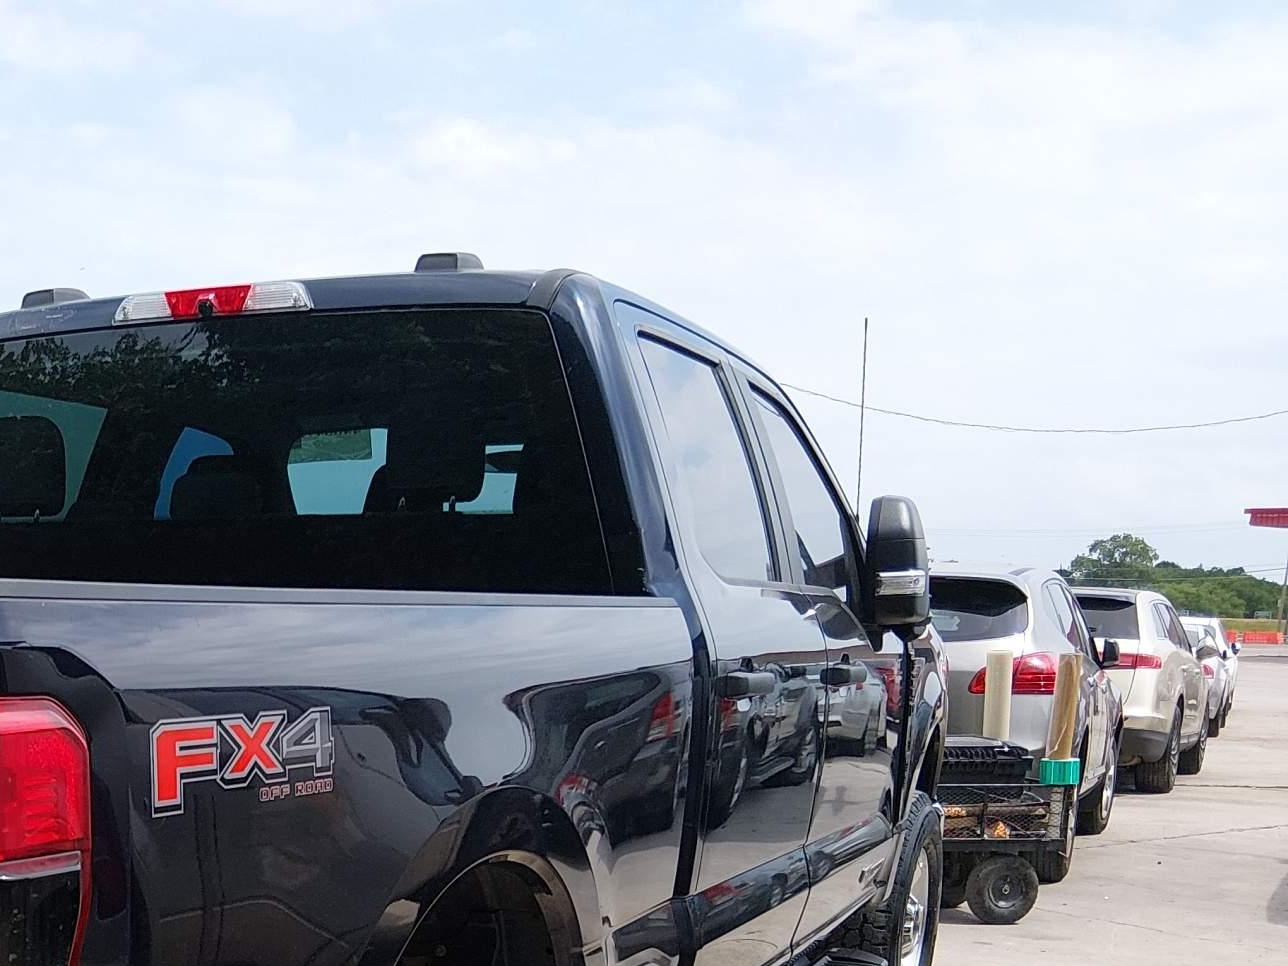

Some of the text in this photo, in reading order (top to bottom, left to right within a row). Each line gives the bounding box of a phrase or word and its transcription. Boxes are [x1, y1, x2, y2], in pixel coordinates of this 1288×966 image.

[150, 706, 335, 818] FX4
[259, 778, 334, 802] OFF ROAD
